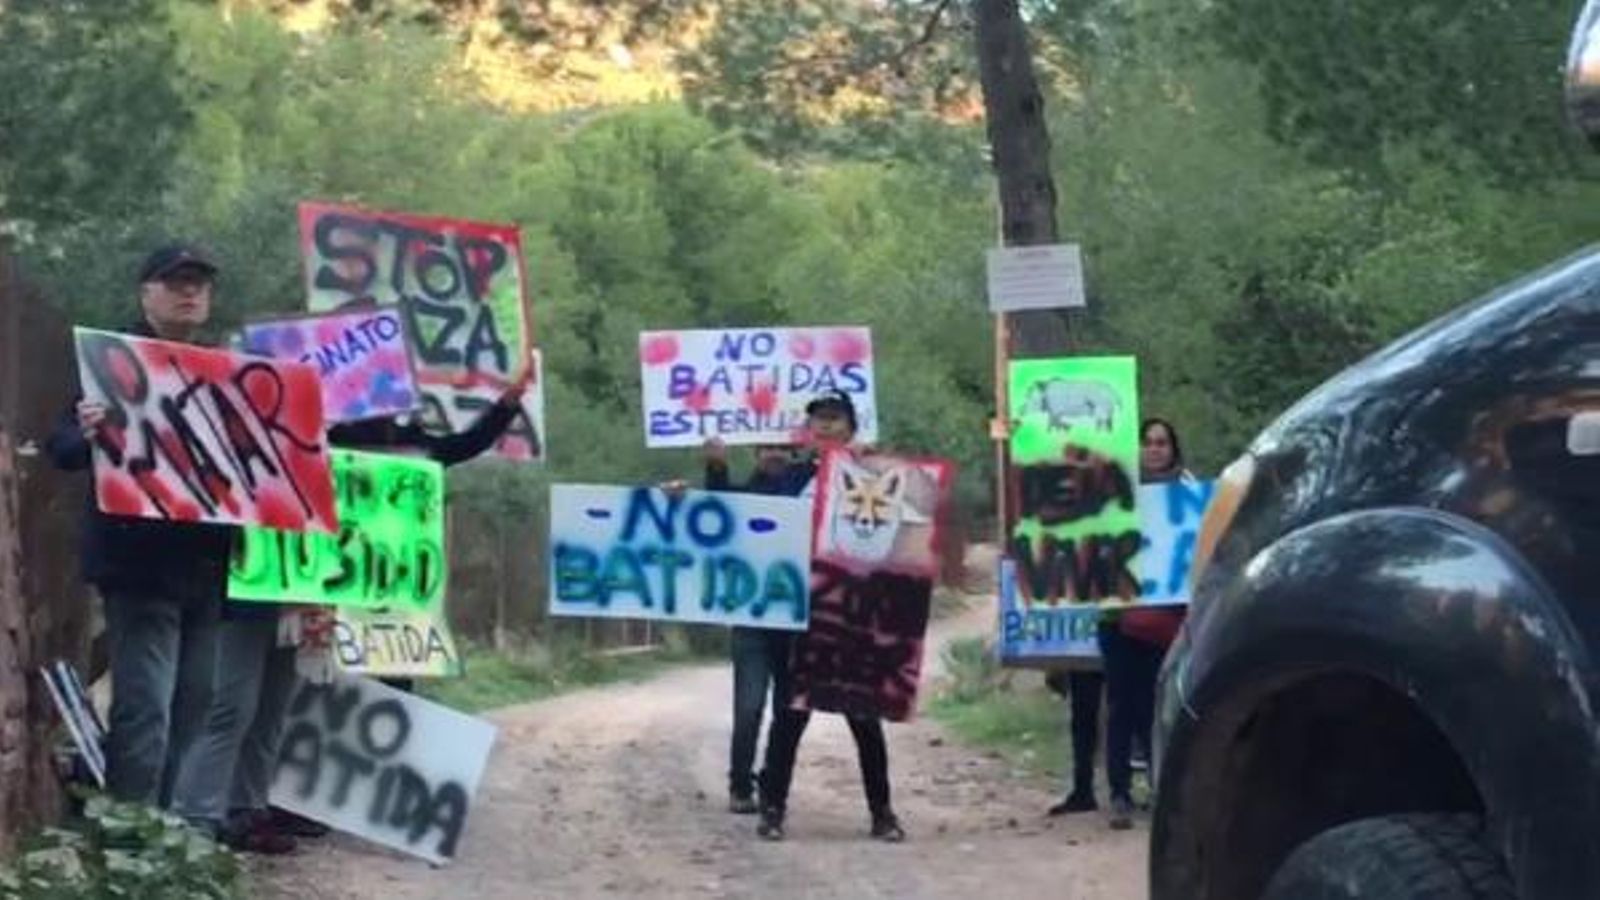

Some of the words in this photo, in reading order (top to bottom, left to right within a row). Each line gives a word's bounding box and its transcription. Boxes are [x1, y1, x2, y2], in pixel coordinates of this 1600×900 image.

[314, 213, 507, 301] STOP
[301, 315, 399, 375] INATO
[713, 331, 776, 361] NO
[667, 361, 868, 399] BATIDAS
[128, 355, 320, 518] MATAR
[619, 487, 735, 548] NO
[554, 544, 806, 621] BATIDA
[336, 619, 452, 666] BATIDA
[274, 719, 468, 858] ATIDA
